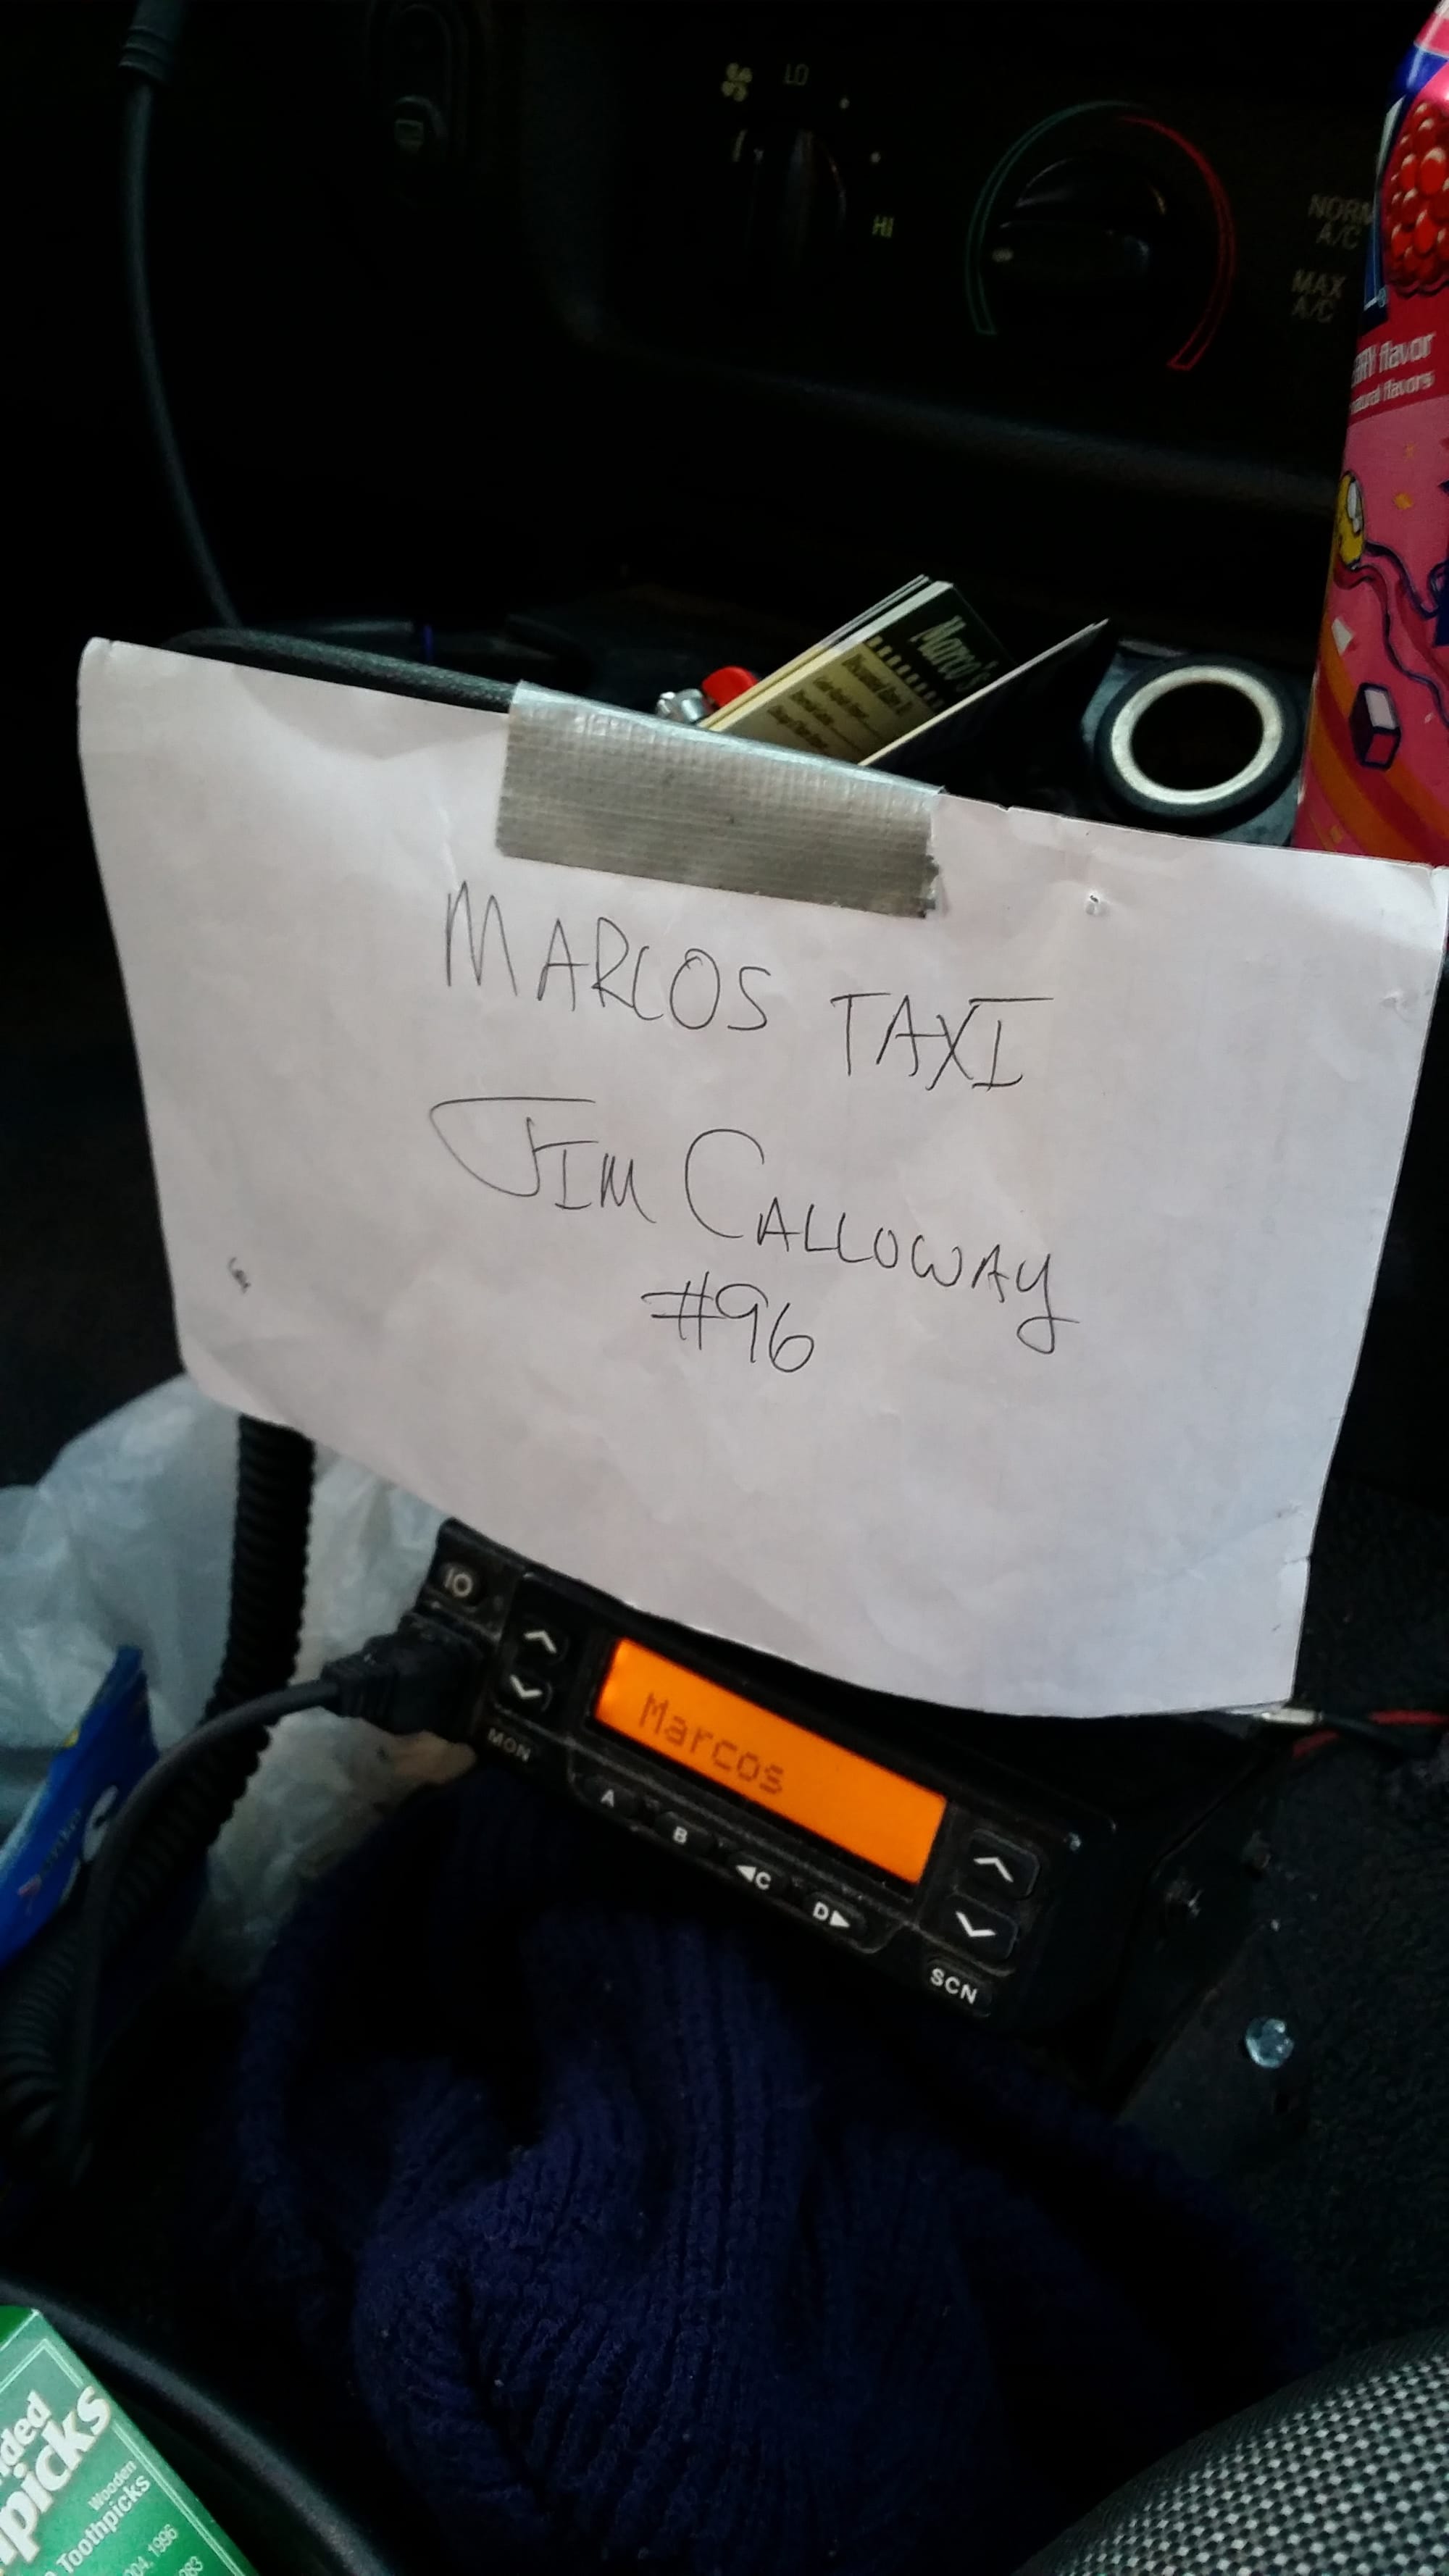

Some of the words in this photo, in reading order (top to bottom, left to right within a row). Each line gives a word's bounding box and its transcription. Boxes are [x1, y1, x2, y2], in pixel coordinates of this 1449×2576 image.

[783, 63, 811, 87] LO
[872, 215, 894, 239] HI
[1316, 220, 1362, 251] A/C
[1290, 267, 1347, 300] MAX
[1290, 295, 1335, 325] A/C
[446, 881, 770, 1030] MARCOS
[831, 992, 1053, 1090] TAXI
[430, 1097, 656, 1224] JIM
[641, 1271, 815, 1373] #96
[487, 1727, 531, 1762] MON
[639, 1691, 785, 1794] Marcos
[600, 1788, 615, 1808] A
[672, 1825, 688, 1846] B
[754, 1870, 772, 1891] C
[812, 1901, 830, 1921] D
[930, 1967, 978, 2005] SCN
[88, 2460, 137, 2511] Wooden
[56, 2475, 151, 2574] Toothpicks
[147, 2523, 178, 2558] 1996
